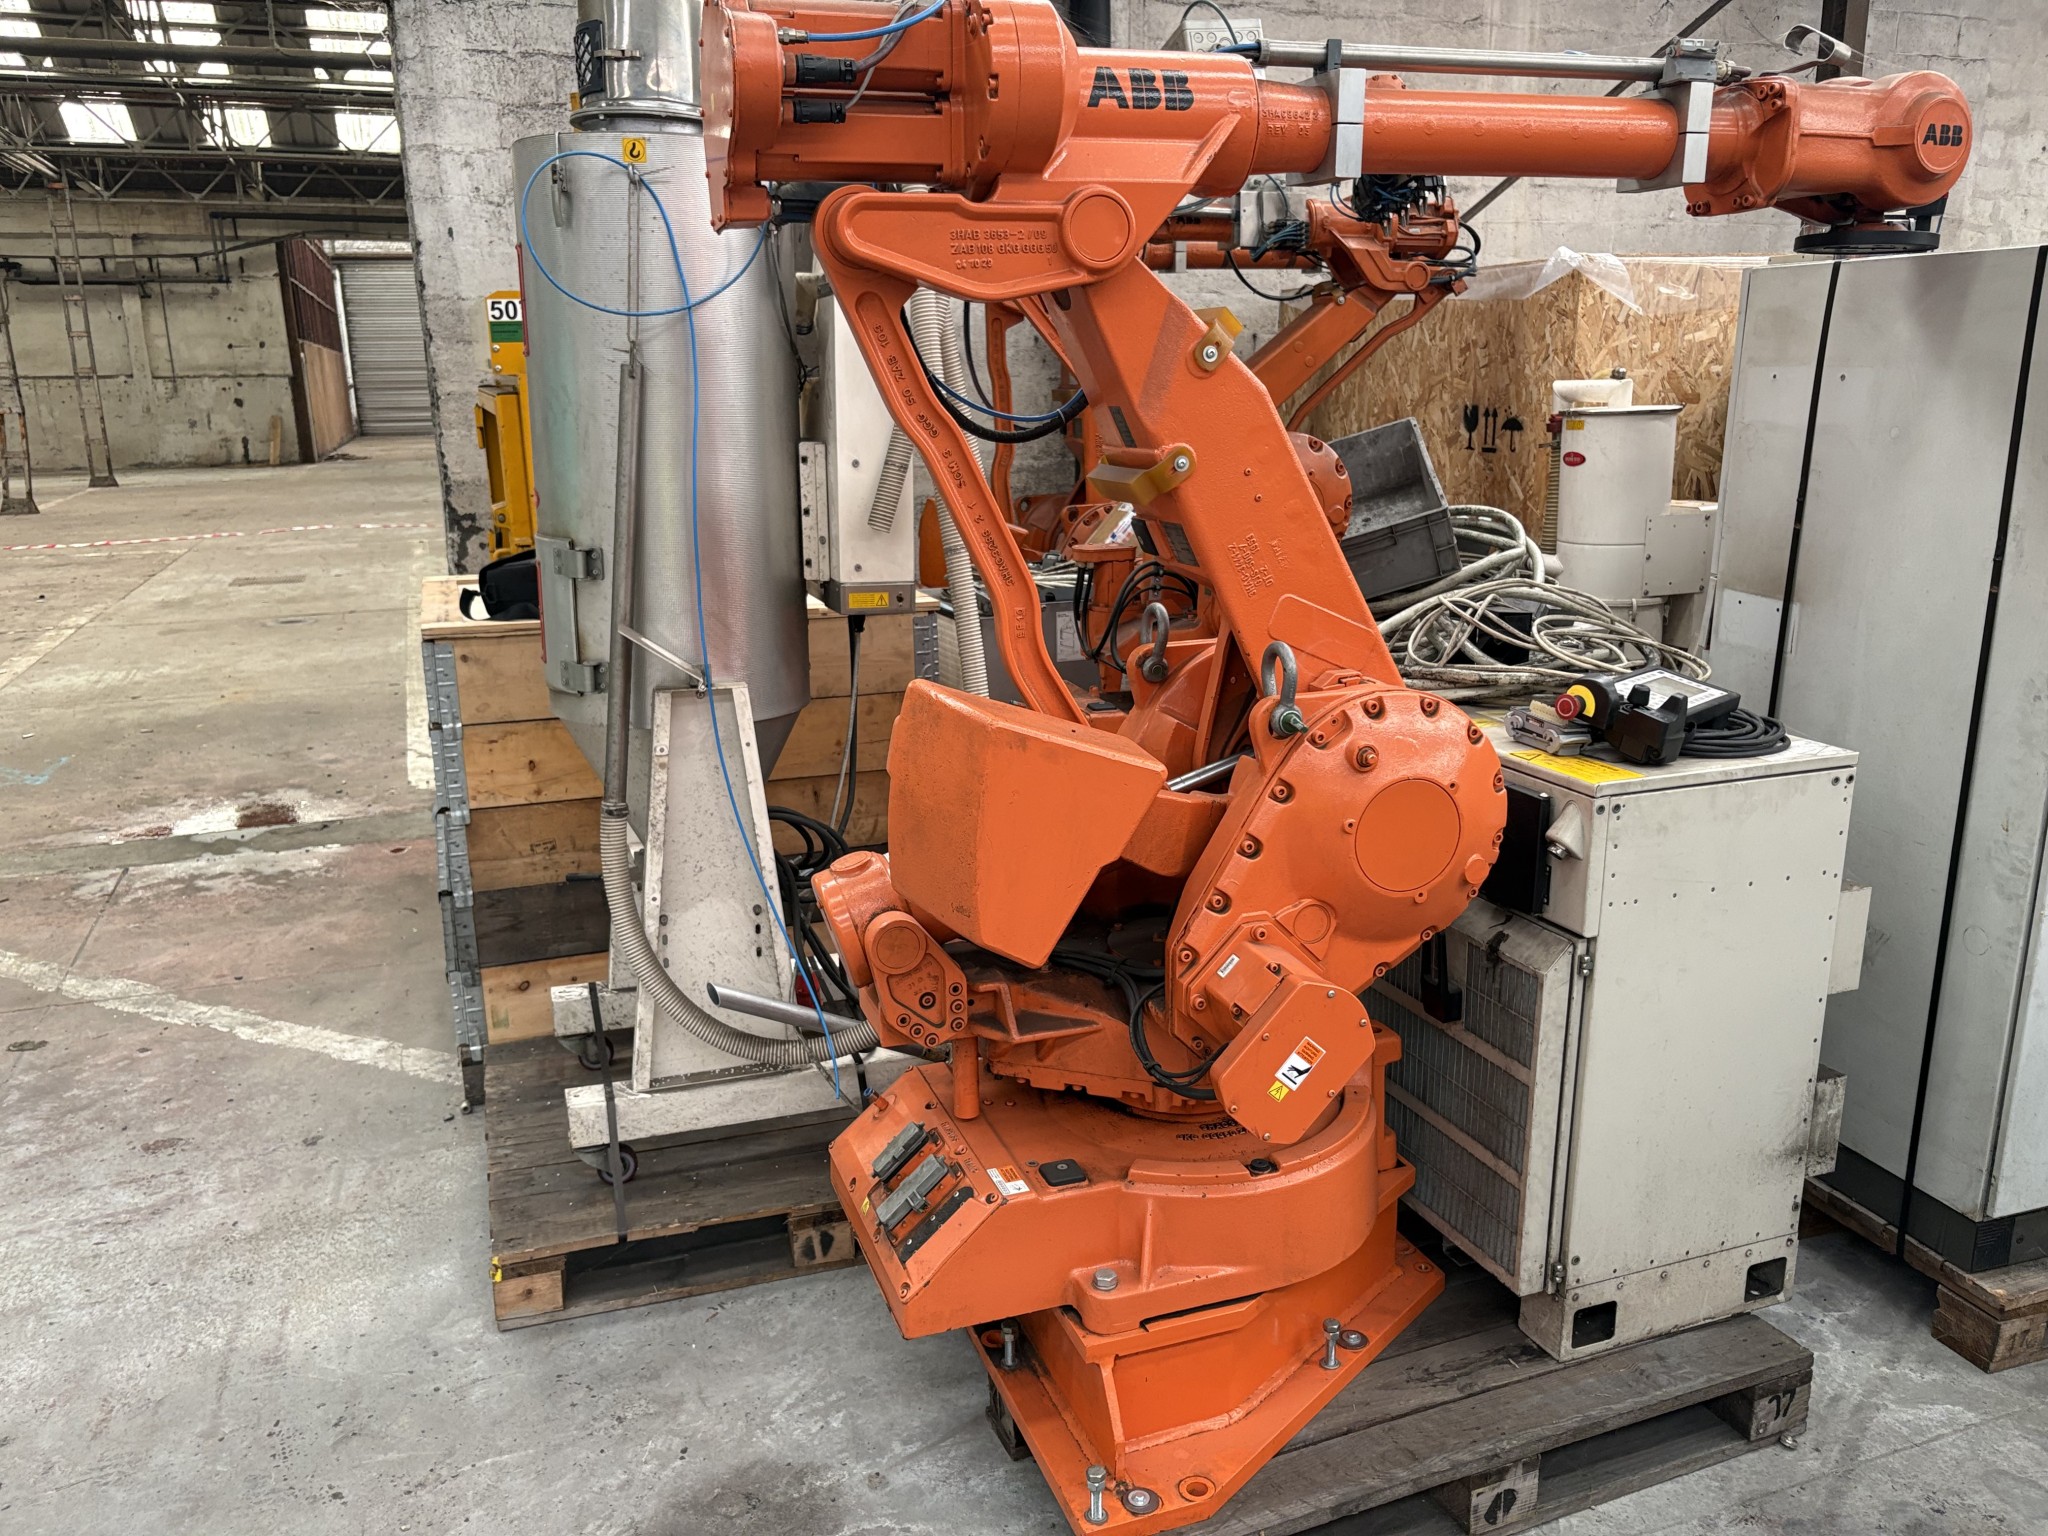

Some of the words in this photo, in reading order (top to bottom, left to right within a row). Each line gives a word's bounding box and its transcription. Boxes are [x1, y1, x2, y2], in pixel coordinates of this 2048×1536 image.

[1087, 66, 1194, 111] ABB
[1922, 123, 1963, 147] ABB
[949, 228, 980, 241] 3HAB
[490, 300, 521, 321] 50
